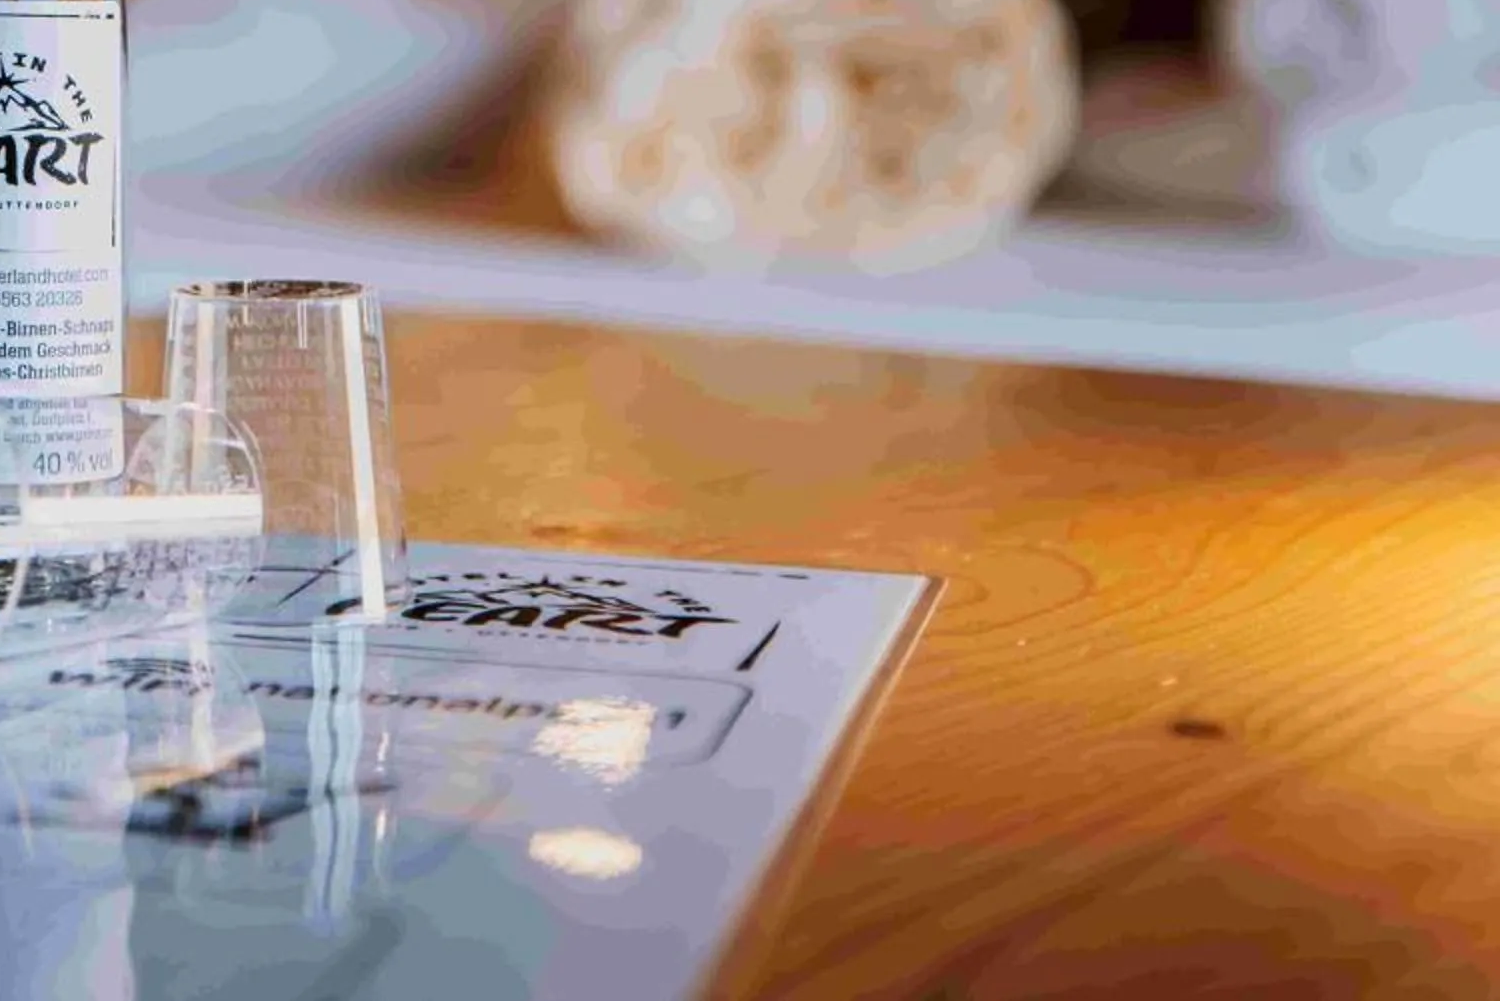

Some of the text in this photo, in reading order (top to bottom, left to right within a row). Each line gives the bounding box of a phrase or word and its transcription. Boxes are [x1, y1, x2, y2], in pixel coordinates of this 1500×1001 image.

[12, 52, 47, 73] IN
[62, 74, 94, 123] THE
[37, 339, 112, 358] Geschmack
[33, 452, 61, 476] 40
[89, 448, 113, 470] vol
